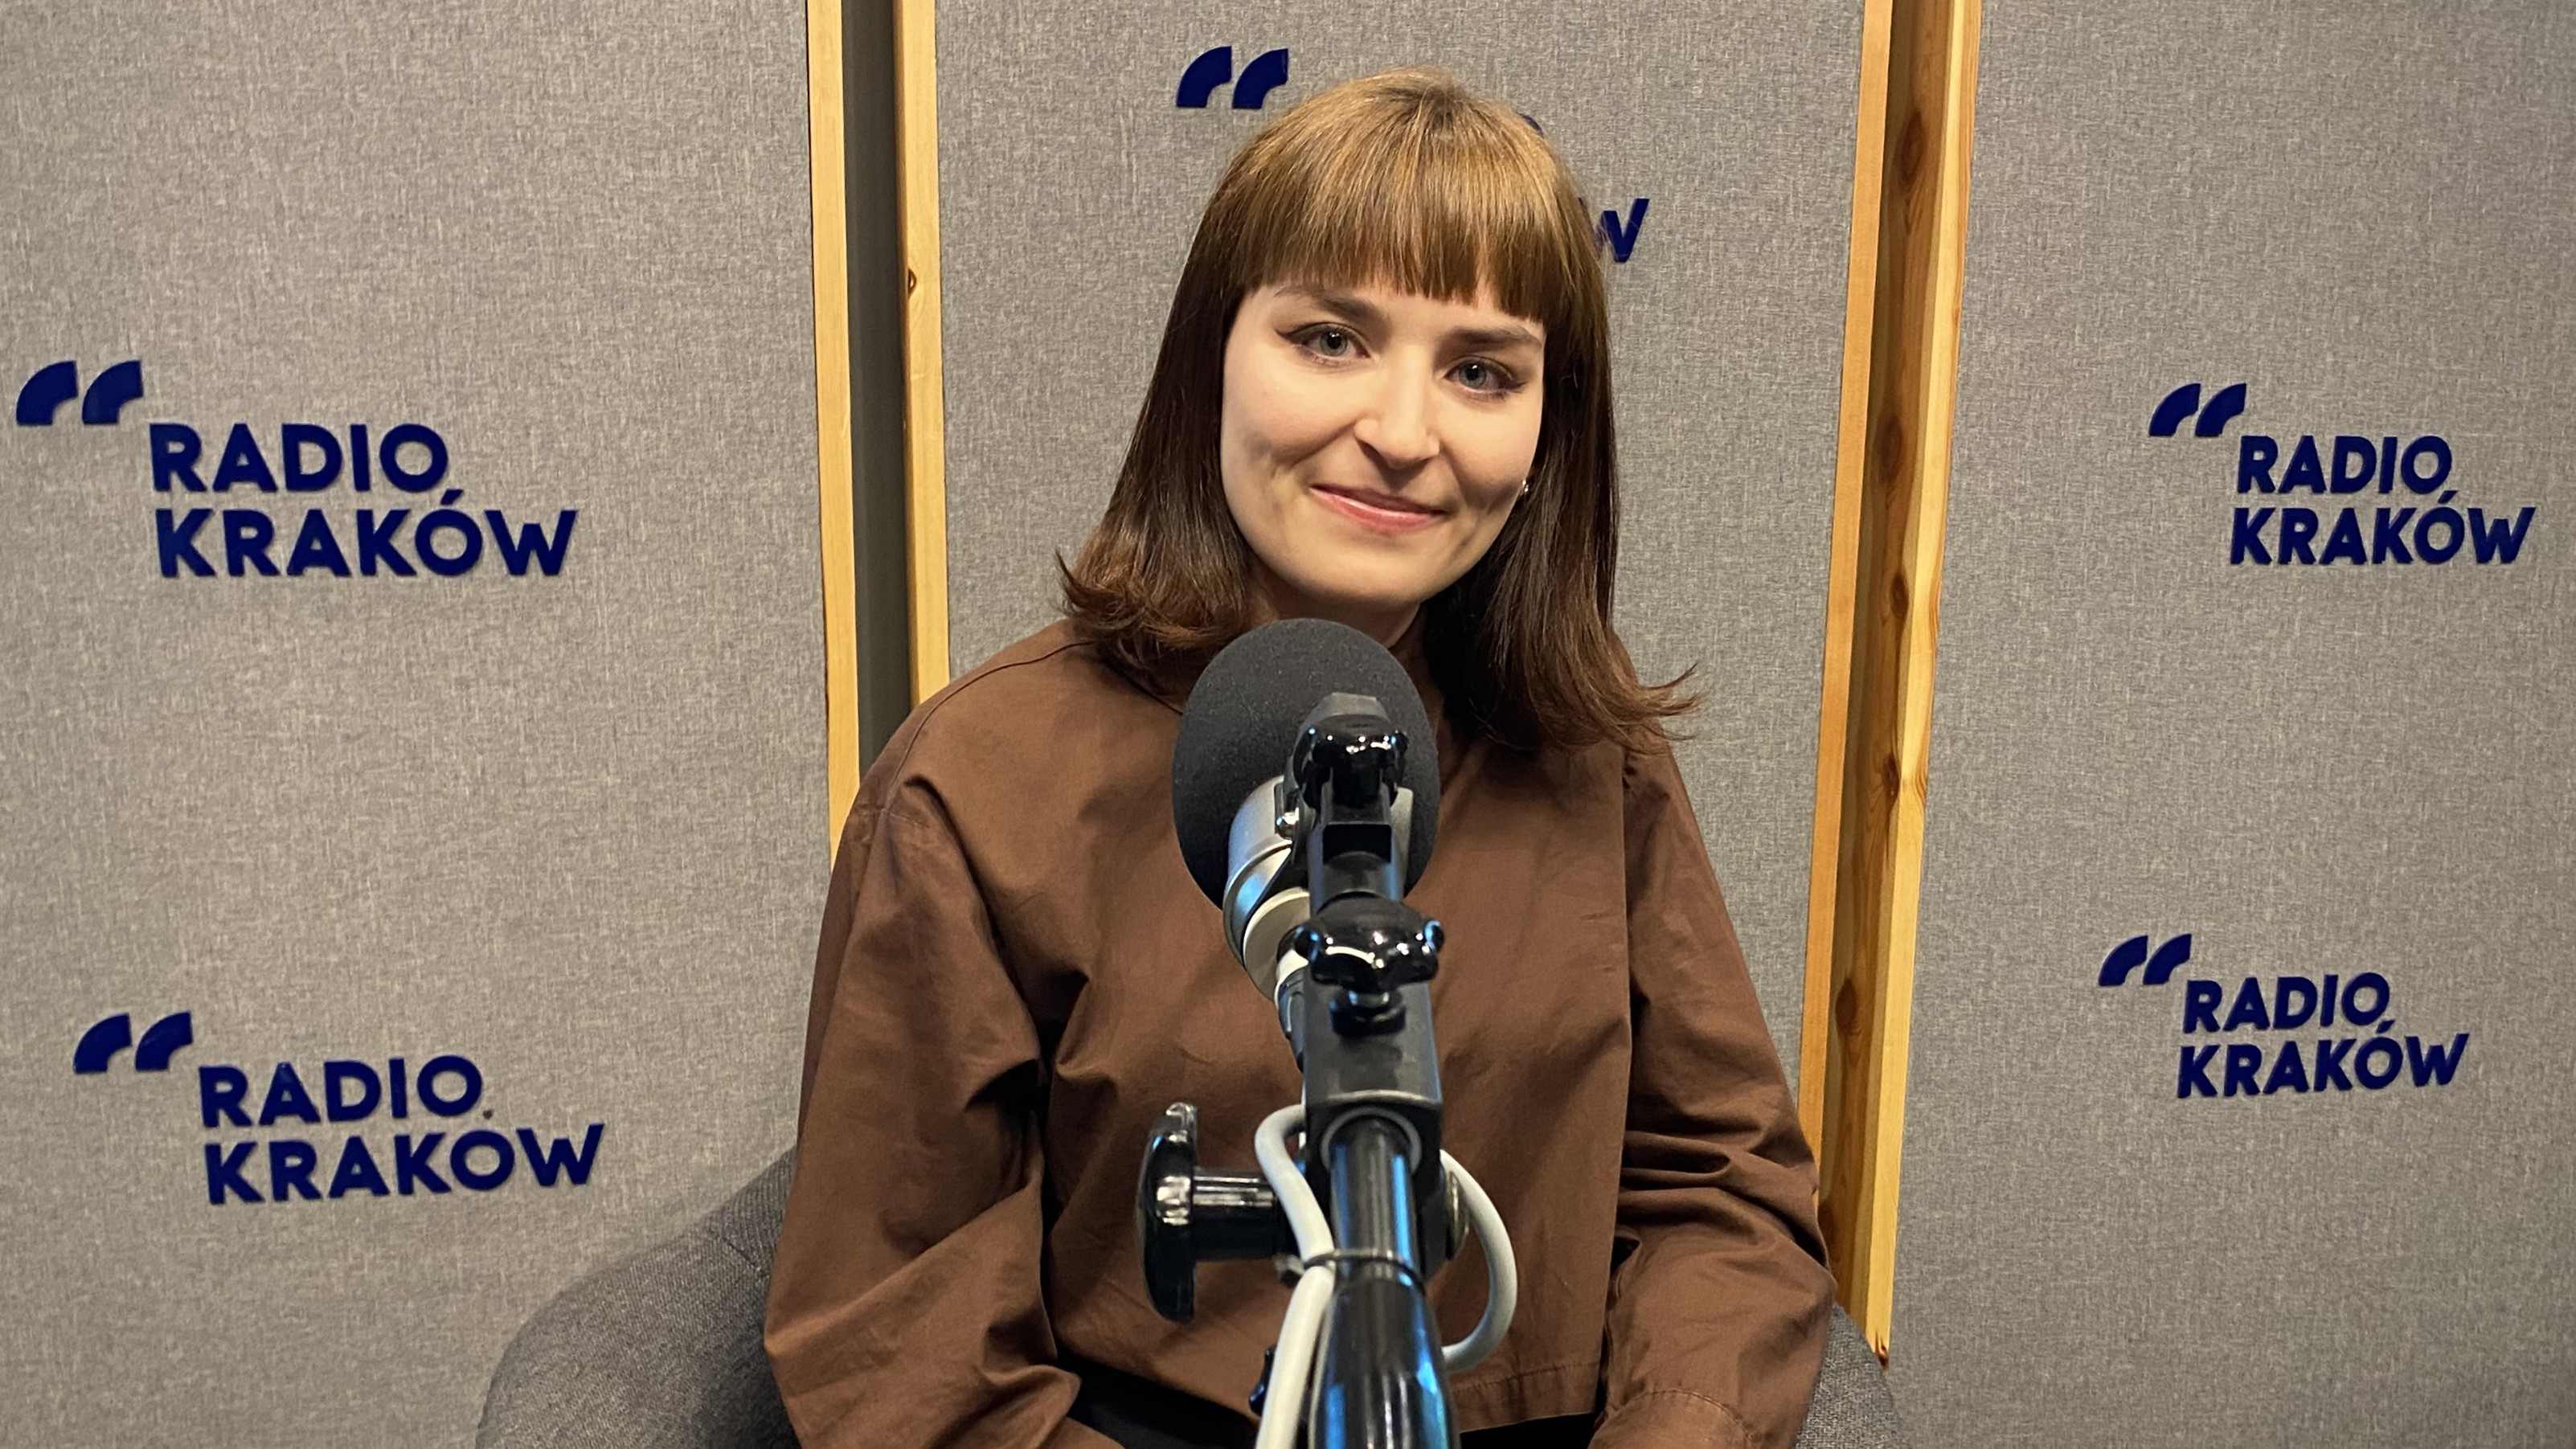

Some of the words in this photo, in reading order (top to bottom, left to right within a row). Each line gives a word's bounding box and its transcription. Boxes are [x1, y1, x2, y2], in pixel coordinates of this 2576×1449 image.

[150, 423, 448, 491] RADIO
[2237, 436, 2452, 493] RADIO
[156, 489, 576, 576] KRAKÓW
[2230, 490, 2536, 564] KRAKÓW
[2183, 972, 2390, 1033] RADIO
[199, 1054, 481, 1128] RADIO
[2177, 1020, 2469, 1098] KRAKÓW
